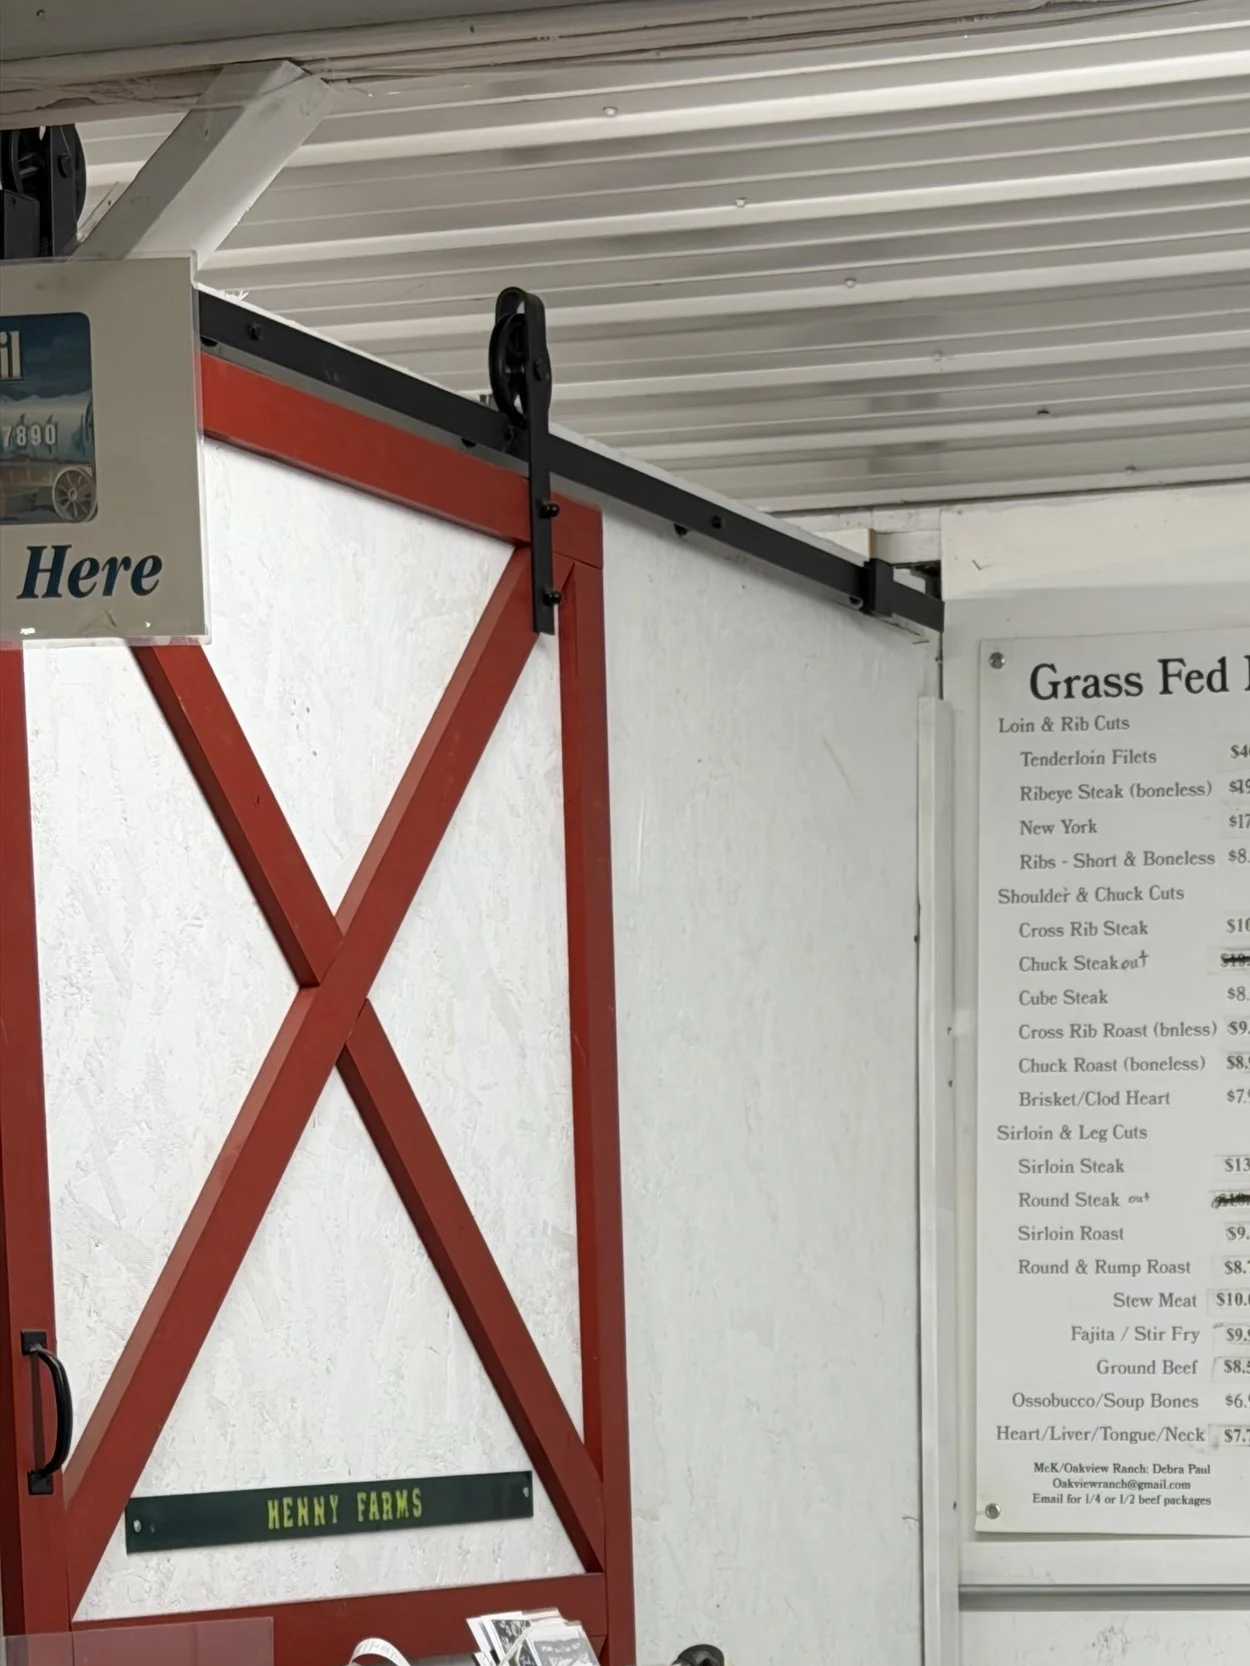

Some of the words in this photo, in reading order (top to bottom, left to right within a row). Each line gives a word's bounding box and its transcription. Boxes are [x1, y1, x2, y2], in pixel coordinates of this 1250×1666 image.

[17, 545, 163, 600] Here
[1030, 663, 1143, 700] Grass
[1157, 656, 1229, 695] Fed
[999, 718, 1034, 733] Loin
[1061, 716, 1091, 731] Rib
[1094, 715, 1130, 730] Cuts
[1020, 750, 1105, 767] Tenderloin
[1112, 749, 1156, 764] Filets
[1020, 820, 1055, 835] New
[1060, 819, 1097, 834] York
[998, 889, 1071, 904] Shoulder
[1095, 886, 1143, 902] Chuck
[1149, 885, 1184, 901] Cuts
[1019, 956, 1068, 972] Chuck
[1074, 955, 1118, 970] Steak
[1019, 990, 1057, 1006] Cube
[1063, 989, 1108, 1004] Steak
[1019, 1091, 1120, 1106] Brisket/Clod
[1126, 1090, 1170, 1105] Heart
[997, 1125, 1053, 1140] Sirloin
[1079, 1124, 1108, 1142] Leg
[1112, 1124, 1148, 1140] Cuts
[1019, 1158, 1074, 1174] Sirloin
[1080, 1158, 1124, 1173] Steak
[1019, 1192, 1069, 1207] Round
[1075, 1192, 1120, 1207] Steak
[1113, 1292, 1153, 1308] Stew
[1159, 1292, 1197, 1307] Meat
[1097, 1360, 1156, 1374] Ground
[1162, 1360, 1198, 1375] Beef
[1012, 1392, 1144, 1411] Ossobucco/Soup
[1151, 1393, 1199, 1408] Bones
[996, 1425, 1205, 1444] Heart/Liver/Tongue/Neck
[1152, 1464, 1184, 1474] Debra
[1188, 1464, 1210, 1474] Paul
[267, 1494, 340, 1530] HENNY
[357, 1488, 423, 1522] FARMS
[1032, 1493, 1063, 1504] Email
[1067, 1494, 1082, 1504] for
[1086, 1494, 1100, 1504] 1/4
[1120, 1494, 1135, 1504] 1/2
[1139, 1494, 1161, 1504] beef
[1164, 1495, 1212, 1508] packages
